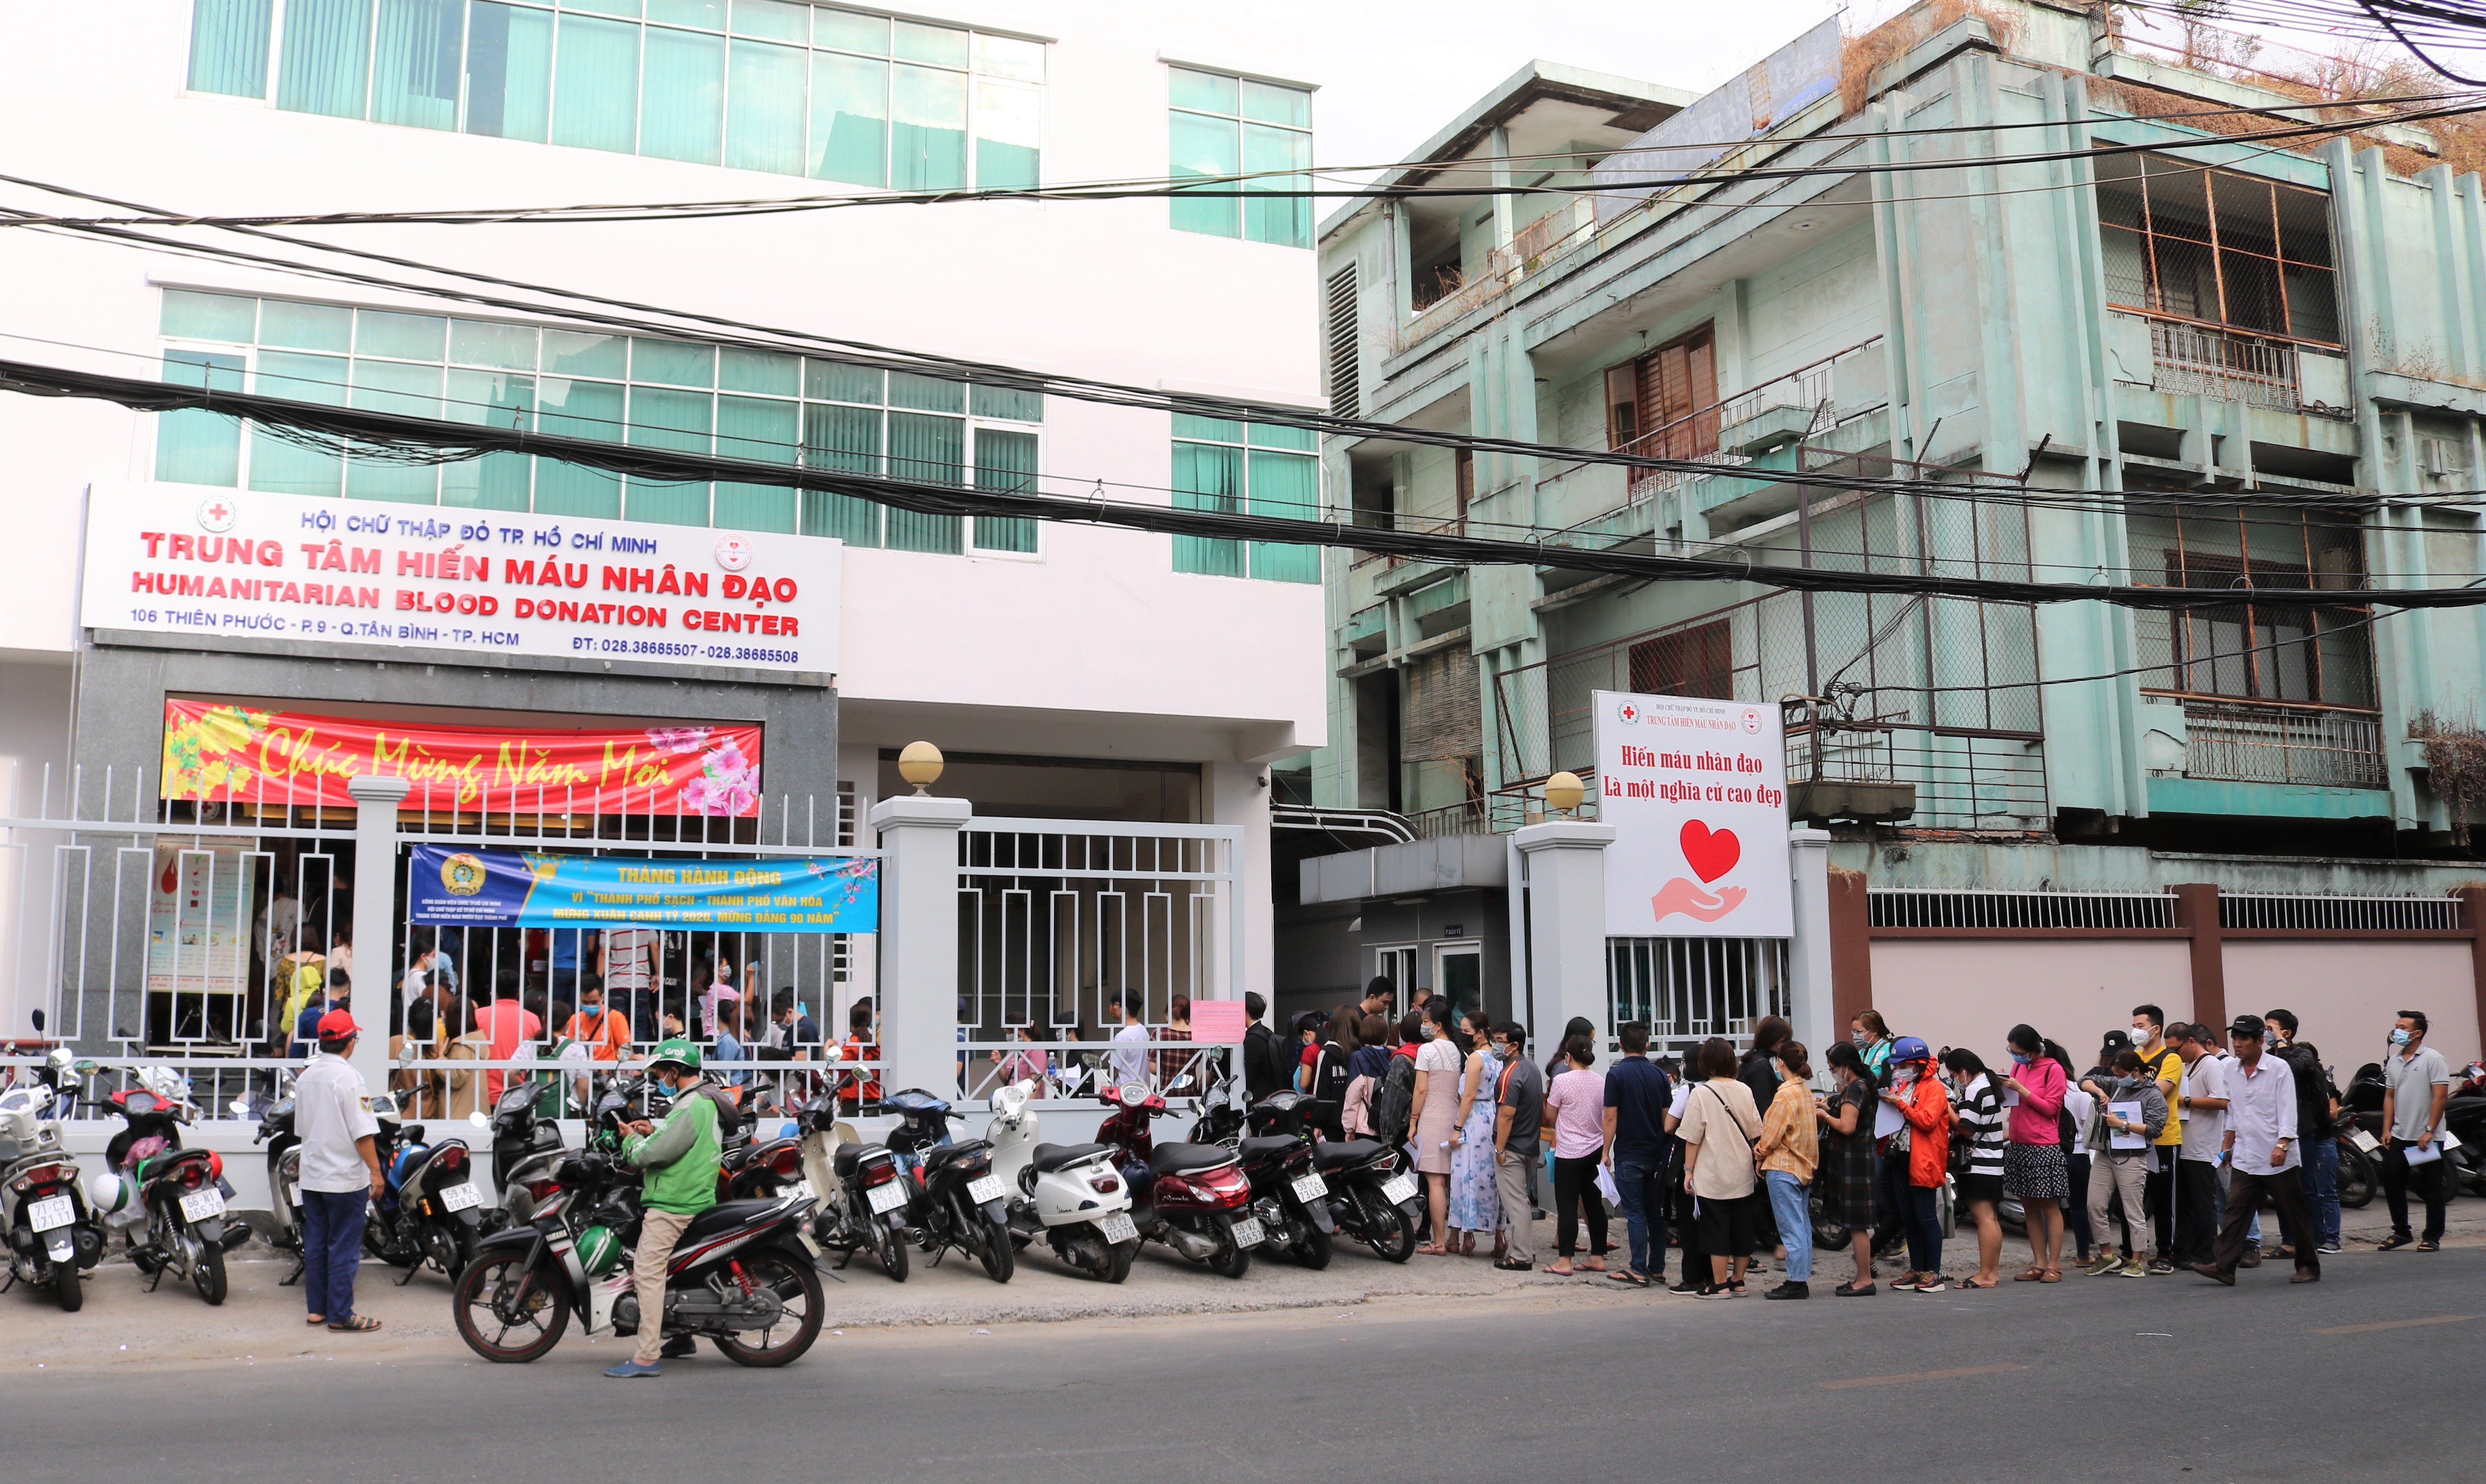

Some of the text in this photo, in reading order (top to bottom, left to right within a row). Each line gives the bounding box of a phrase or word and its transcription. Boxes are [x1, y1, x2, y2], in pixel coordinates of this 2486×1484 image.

[302, 510, 657, 554] HỘI CHỮ THẬP ĐỎ TP. HỒ CHÍ MINH
[141, 531, 798, 608] TRUNG TÂM HIẾN MÁU NHÂN ĐẠO
[132, 571, 799, 637] HUMANITARIAN BLOOD DONATION CENTER
[131, 609, 157, 622] 106
[165, 610, 217, 626] THIÊN
[223, 612, 285, 631] PHƯỚC
[341, 622, 392, 638] Q.TÂN
[398, 625, 438, 640] BÌNH
[453, 630, 476, 643] TP.
[482, 633, 519, 646] HCM
[573, 637, 598, 651] ĐT:
[1646, 715, 1666, 726] TRUNG
[1667, 714, 1679, 727] TÂM
[1680, 716, 1694, 728] HIẾN
[1695, 717, 1707, 728] MÁU
[1708, 717, 1724, 730] NHÂN
[1725, 721, 1736, 732] ĐẠO
[260, 727, 674, 804] Chúc Mừng Năm Mới
[1621, 745, 1763, 776] Hiến máu nhân đạo
[1604, 775, 1783, 808] Là một nghĩa cử cao đẹp
[617, 865, 782, 888] THÁNG HÀNH ĐỘNG
[572, 890, 584, 903] VÌ
[636, 891, 661, 905] PHỐ
[663, 895, 695, 907] SẠCH
[707, 894, 744, 906] THÀNH
[748, 893, 770, 906] PHỐ
[774, 895, 797, 907] VĂN
[801, 895, 823, 907] HÓA
[553, 907, 590, 919] MỪNG
[594, 908, 626, 920] XUÂN
[630, 911, 662, 921] CANH
[682, 912, 714, 922] 2020.
[717, 911, 752, 923] MỪNG
[755, 910, 787, 923] ĐẢNG
[790, 913, 804, 923] 90
[665, 1048, 686, 1057] Grab
[972, 1177, 996, 1191] 67-F1
[1296, 1175, 1319, 1192] 59-P2
[1386, 1178, 1407, 1194] 59-P2
[186, 1192, 215, 1207] 66-N1
[446, 1185, 474, 1200] 59-M2
[974, 1184, 1004, 1203] 339.22
[1299, 1183, 1326, 1203] 734.65
[1389, 1185, 1415, 1205] 391.49
[35, 1200, 65, 1217] 71-C3
[187, 1202, 223, 1219] 065.29
[447, 1194, 482, 1211] 008.43
[877, 1194, 903, 1210] 4200
[34, 1211, 74, 1230] 171.11
[1107, 1217, 1128, 1230] 59-C2
[1235, 1220, 1256, 1235] 59-V2
[545, 1229, 568, 1242] YAMAHA
[1237, 1228, 1263, 1247] 396.53
